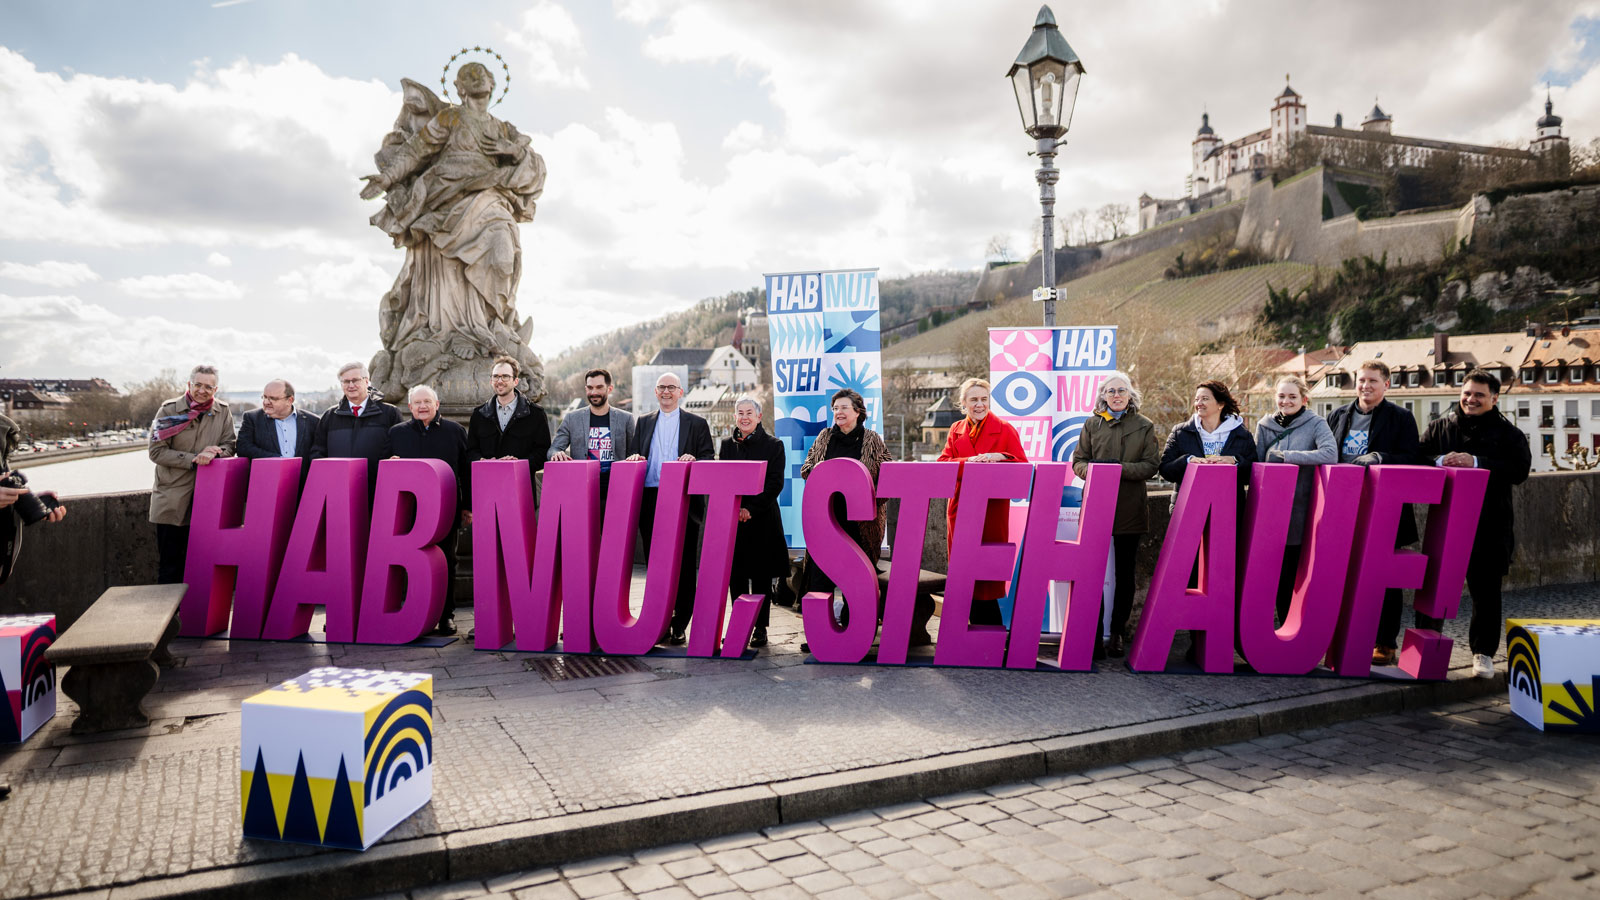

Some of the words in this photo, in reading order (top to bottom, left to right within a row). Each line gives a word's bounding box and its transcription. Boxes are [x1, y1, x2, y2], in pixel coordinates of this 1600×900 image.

[770, 274, 820, 312] HAB
[825, 272, 876, 309] MUT,
[1055, 329, 1114, 367] HAB
[776, 358, 821, 393] STEH
[180, 456, 457, 645] HAB
[471, 459, 768, 658] MUT,
[801, 457, 1122, 670] STEH
[1126, 462, 1491, 680] AUF!
